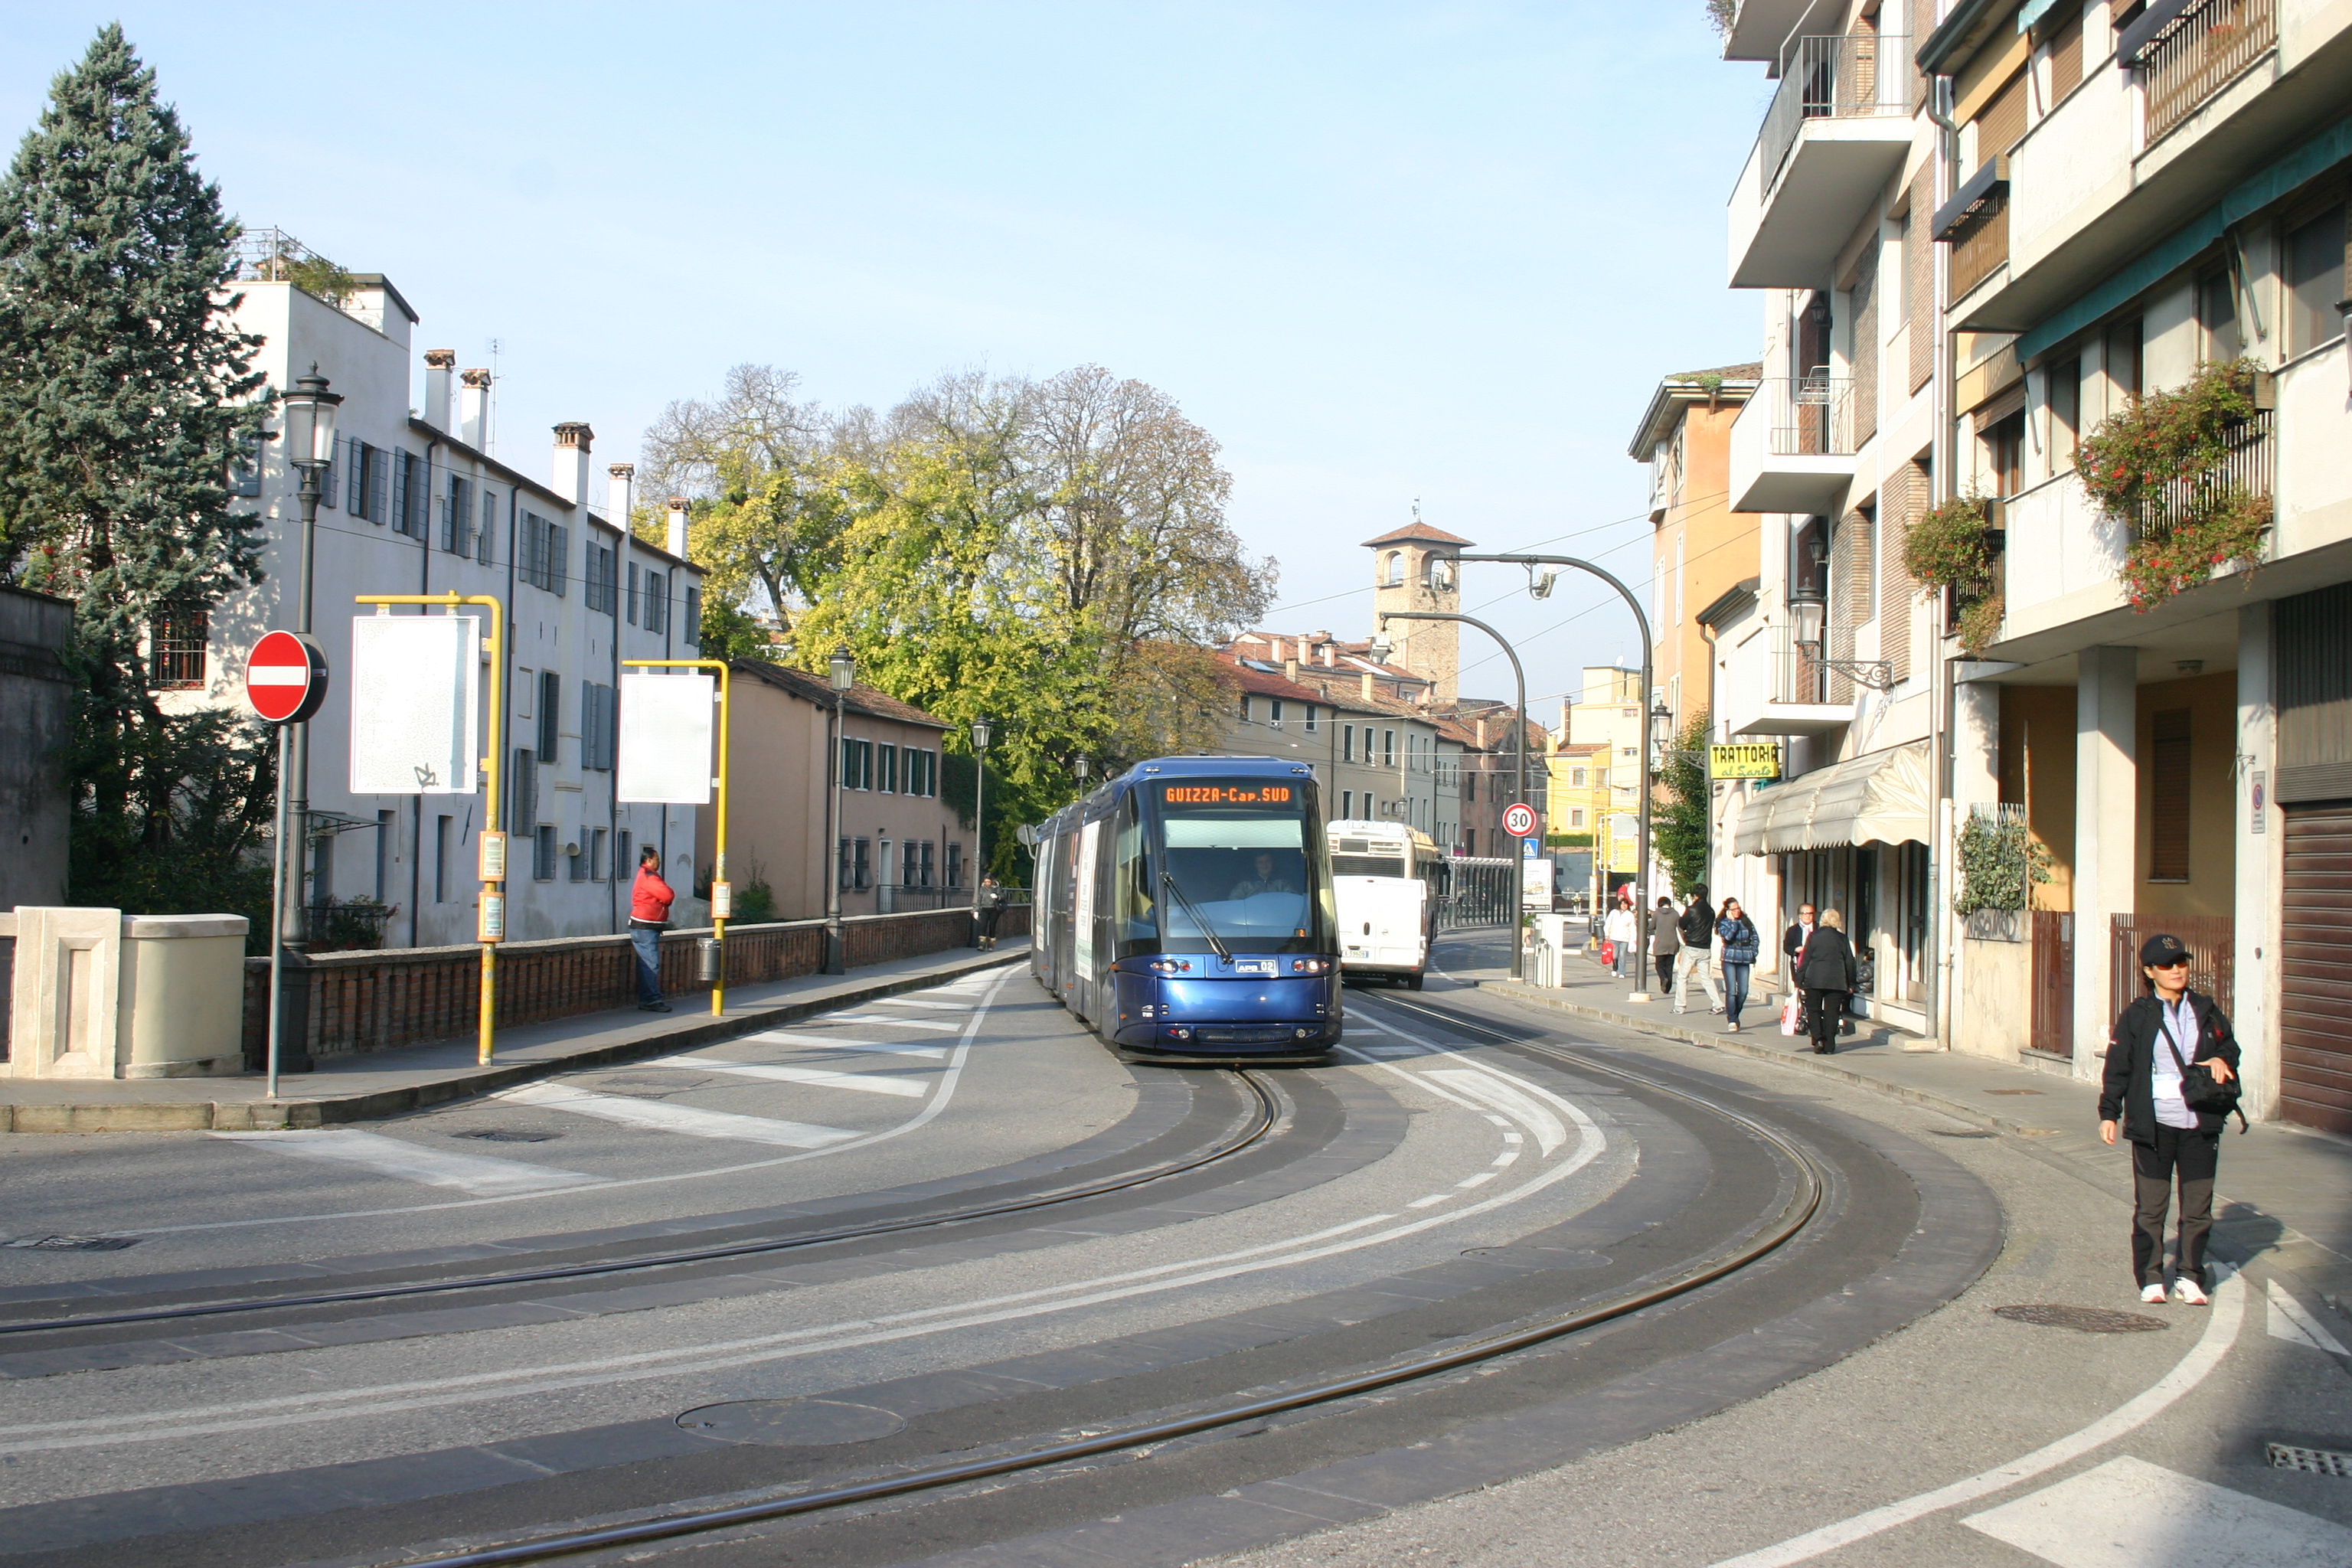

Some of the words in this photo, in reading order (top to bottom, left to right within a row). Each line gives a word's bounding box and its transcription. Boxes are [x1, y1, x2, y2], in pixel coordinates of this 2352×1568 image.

[1713, 746, 1776, 763] TRATTORIA
[1721, 766, 1733, 776] al
[1737, 765, 1772, 777] Santo
[1511, 812, 1528, 827] 30
[1260, 961, 1273, 972] 02
